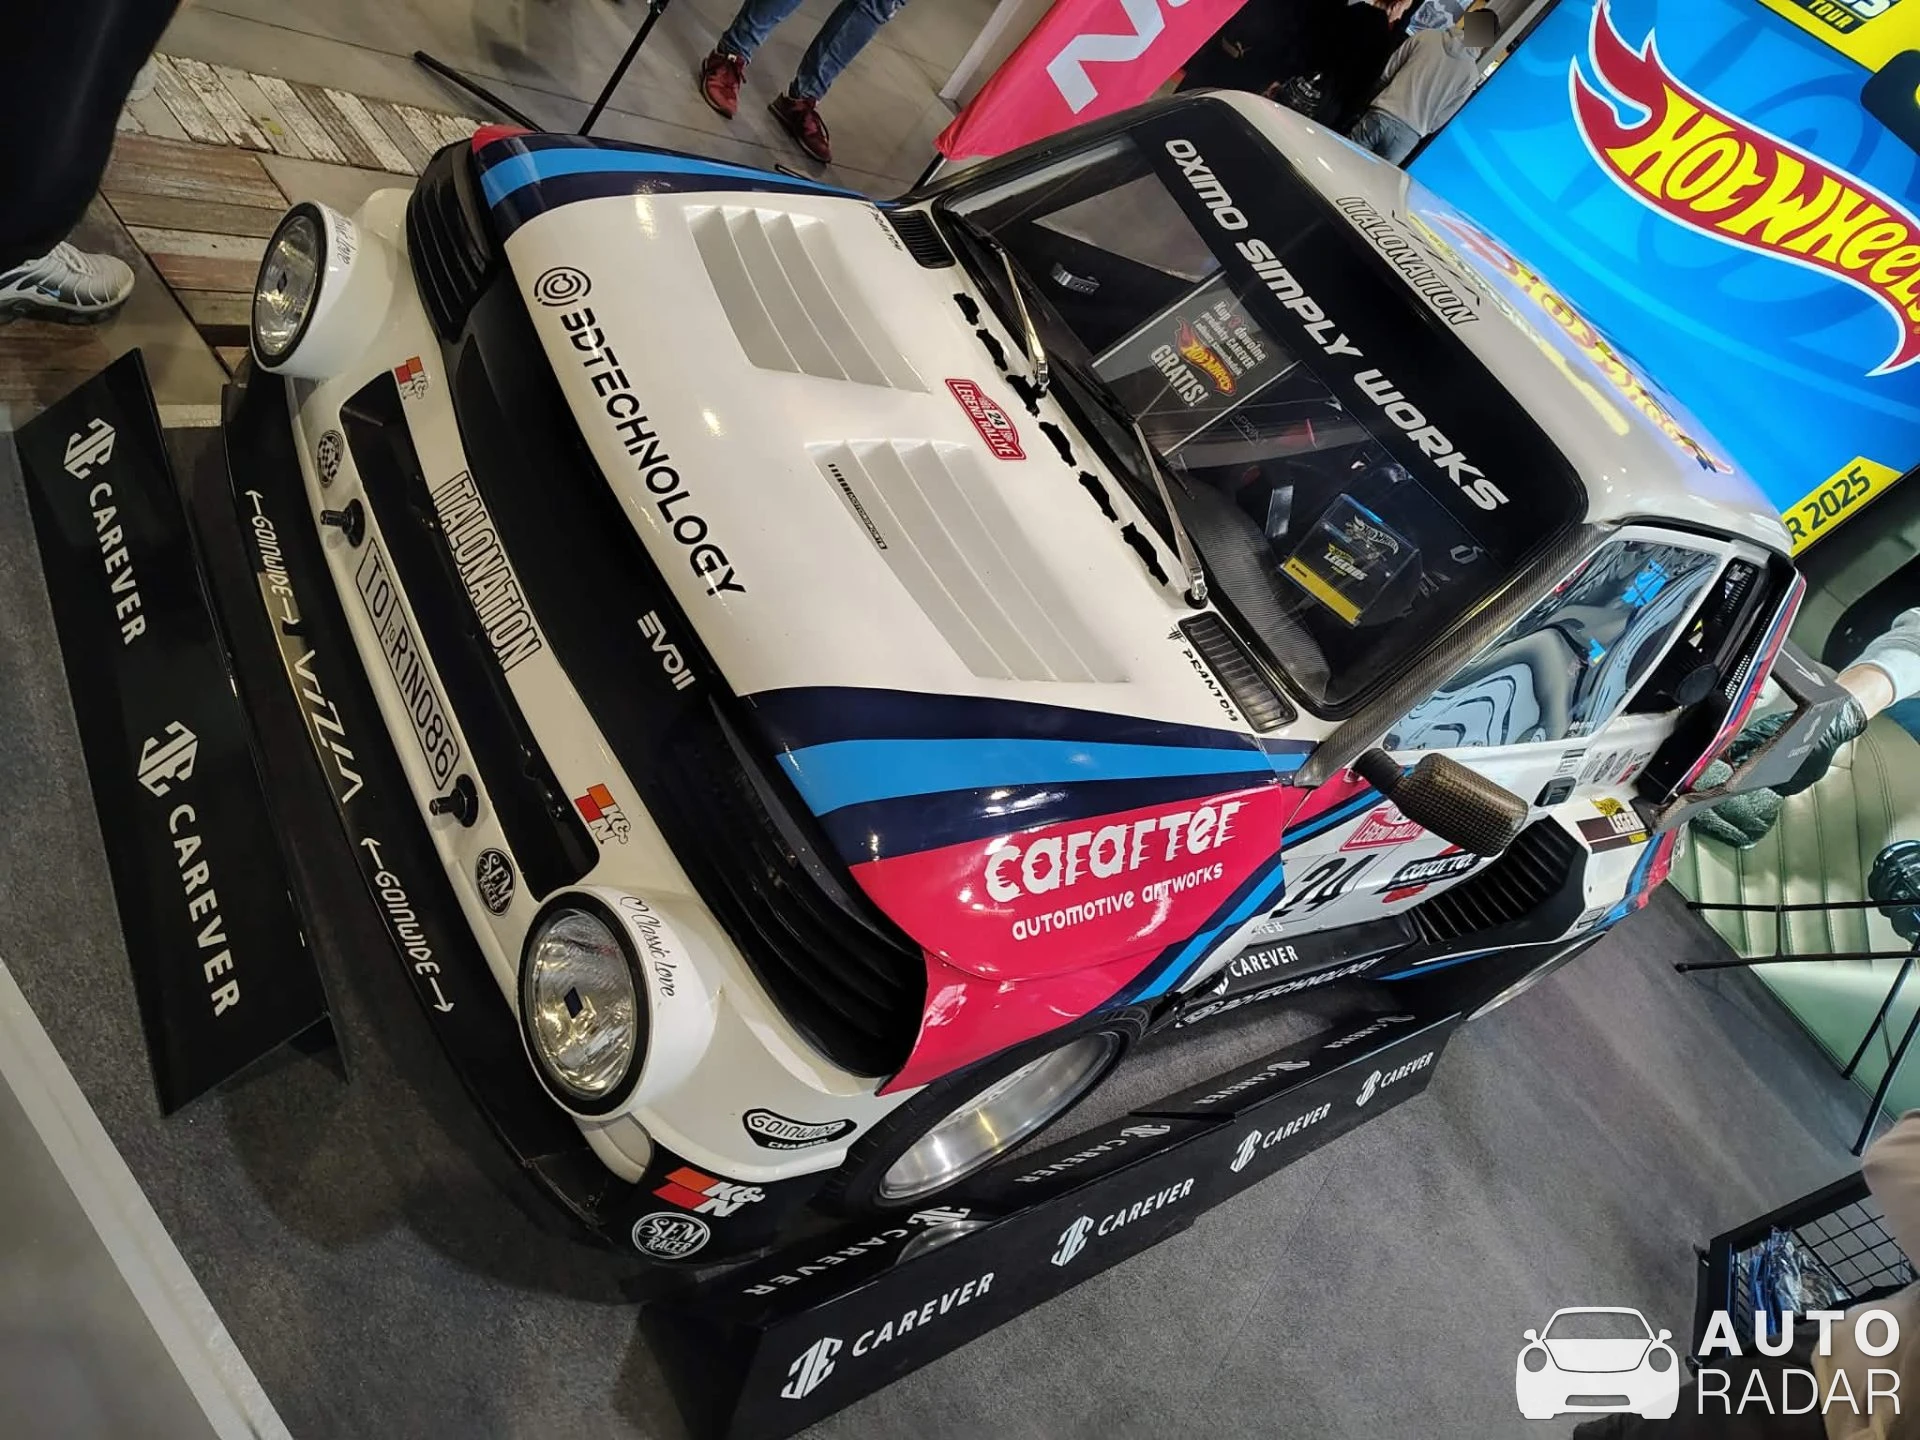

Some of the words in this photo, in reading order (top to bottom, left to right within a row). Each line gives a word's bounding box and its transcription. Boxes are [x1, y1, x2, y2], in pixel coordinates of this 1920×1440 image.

[1336, 197, 1480, 325] ITALONATION
[1165, 139, 1248, 231] OXIMO
[1235, 239, 1363, 357] SIMPLY
[1353, 368, 1509, 511] WORKS
[1227, 338, 1256, 369] CAREVER
[1149, 343, 1209, 407] GRATIS!
[953, 384, 985, 418] LEGEND
[978, 421, 1018, 455] RALLYE
[987, 412, 1006, 426] 24
[1802, 466, 1871, 531] 2025
[89, 482, 146, 645] CAREVER
[252, 515, 293, 598] GOINWIDE
[432, 470, 542, 674] ITALONATION
[169, 803, 240, 1017] CAREVER
[1269, 853, 1379, 919] 24
[375, 871, 440, 975] GOINWIDE
[634, 913, 666, 960] Classic
[654, 959, 676, 998] Love
[1230, 945, 1299, 977] CAREVER
[1380, 1051, 1435, 1088] CAREVER
[1261, 1102, 1332, 1149] CAREVER
[1013, 1138, 1128, 1183] CAREVER
[1097, 1177, 1195, 1237] CAREVER
[646, 1237, 693, 1253] RACER
[742, 1228, 909, 1295] CAREVER
[851, 1272, 995, 1357] CAREVER
